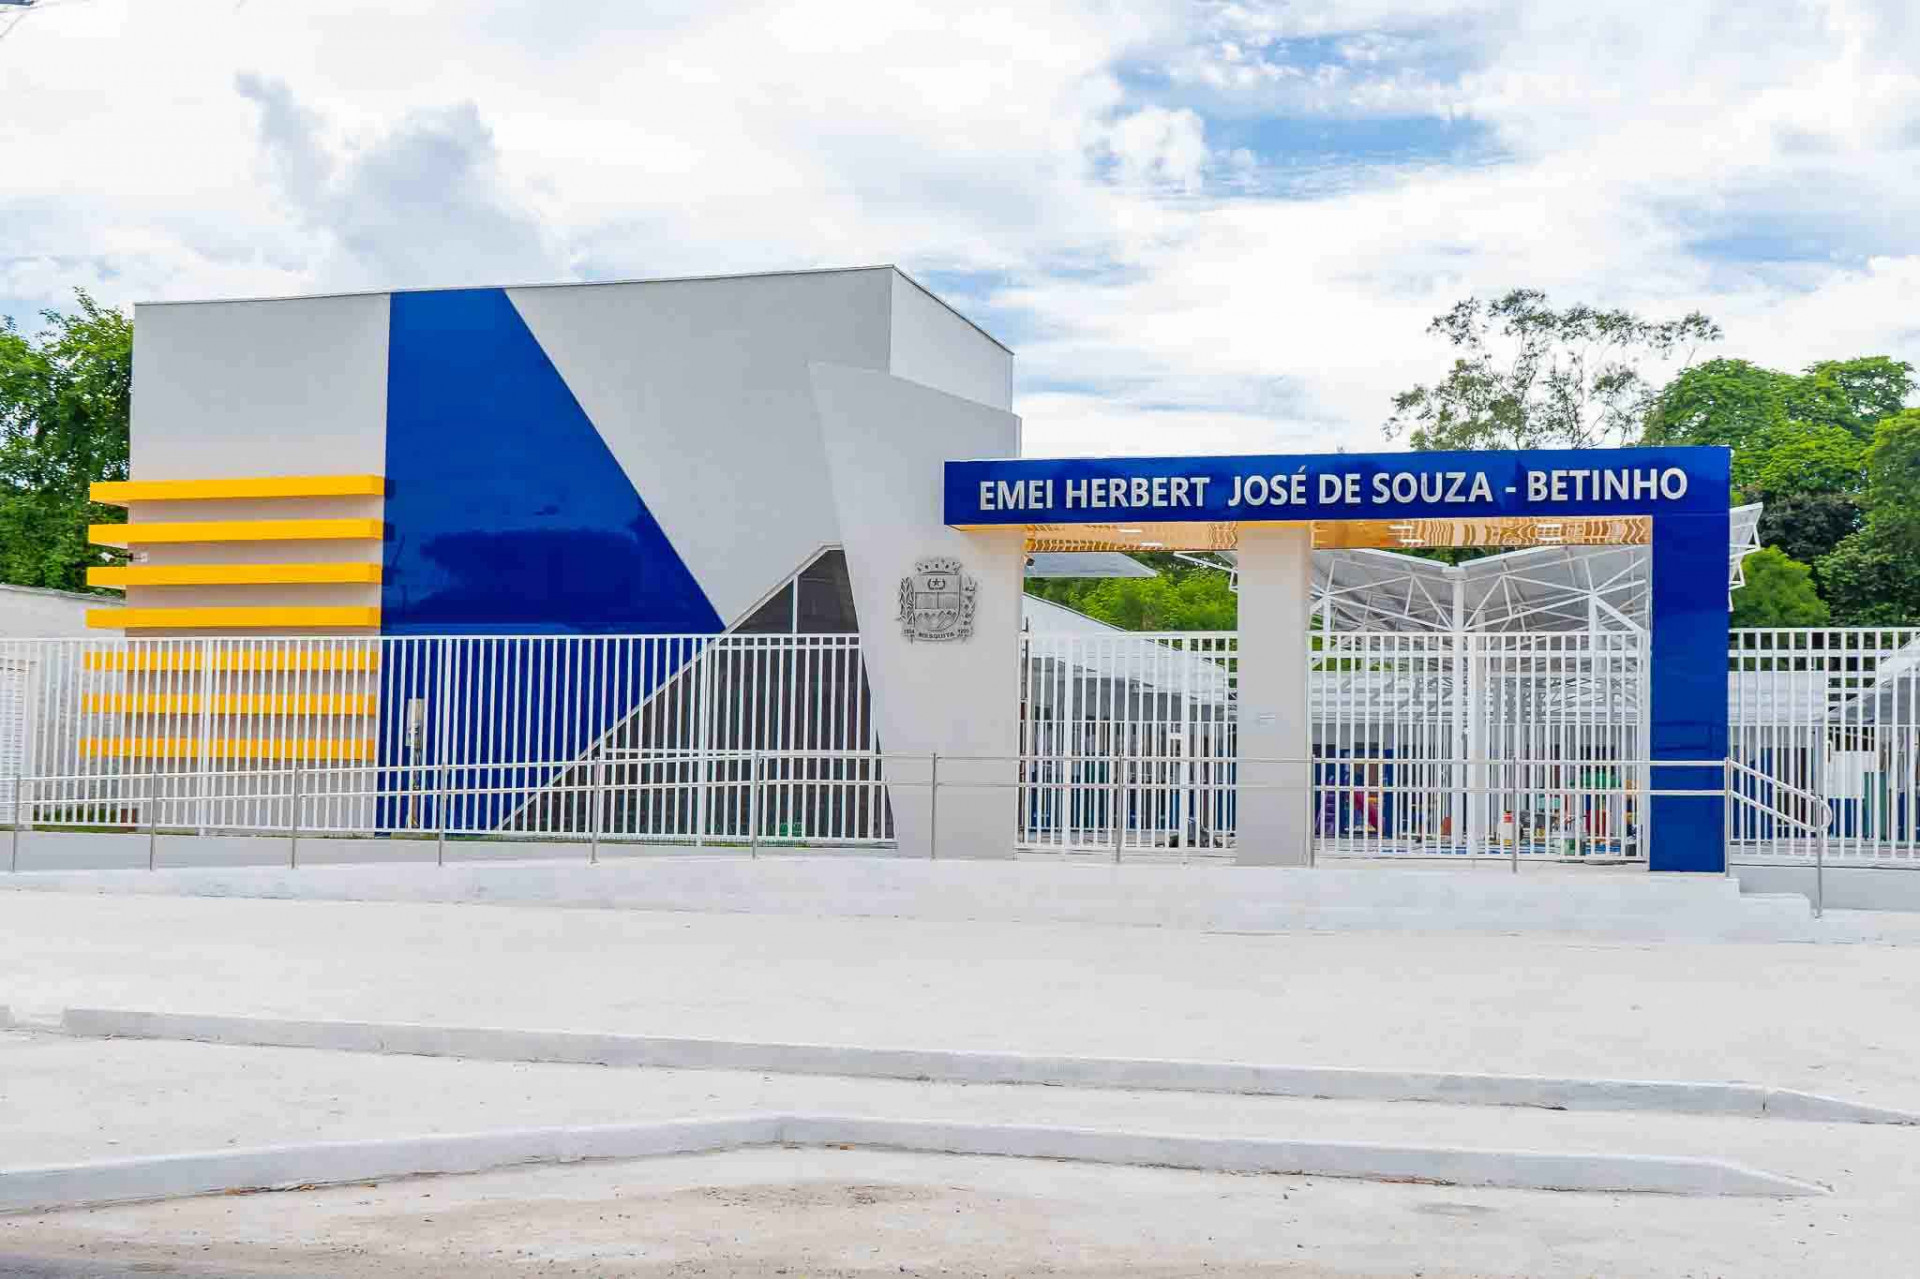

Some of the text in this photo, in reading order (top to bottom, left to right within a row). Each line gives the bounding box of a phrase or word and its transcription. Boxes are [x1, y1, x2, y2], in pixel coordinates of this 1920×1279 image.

[981, 479, 1053, 511] EMEI
[1066, 476, 1211, 509] HERBERT
[1229, 465, 1307, 507] JOSÉ
[1320, 474, 1361, 504] DE
[1373, 470, 1493, 504] SOUZA
[1528, 467, 1688, 502] BETINHO
